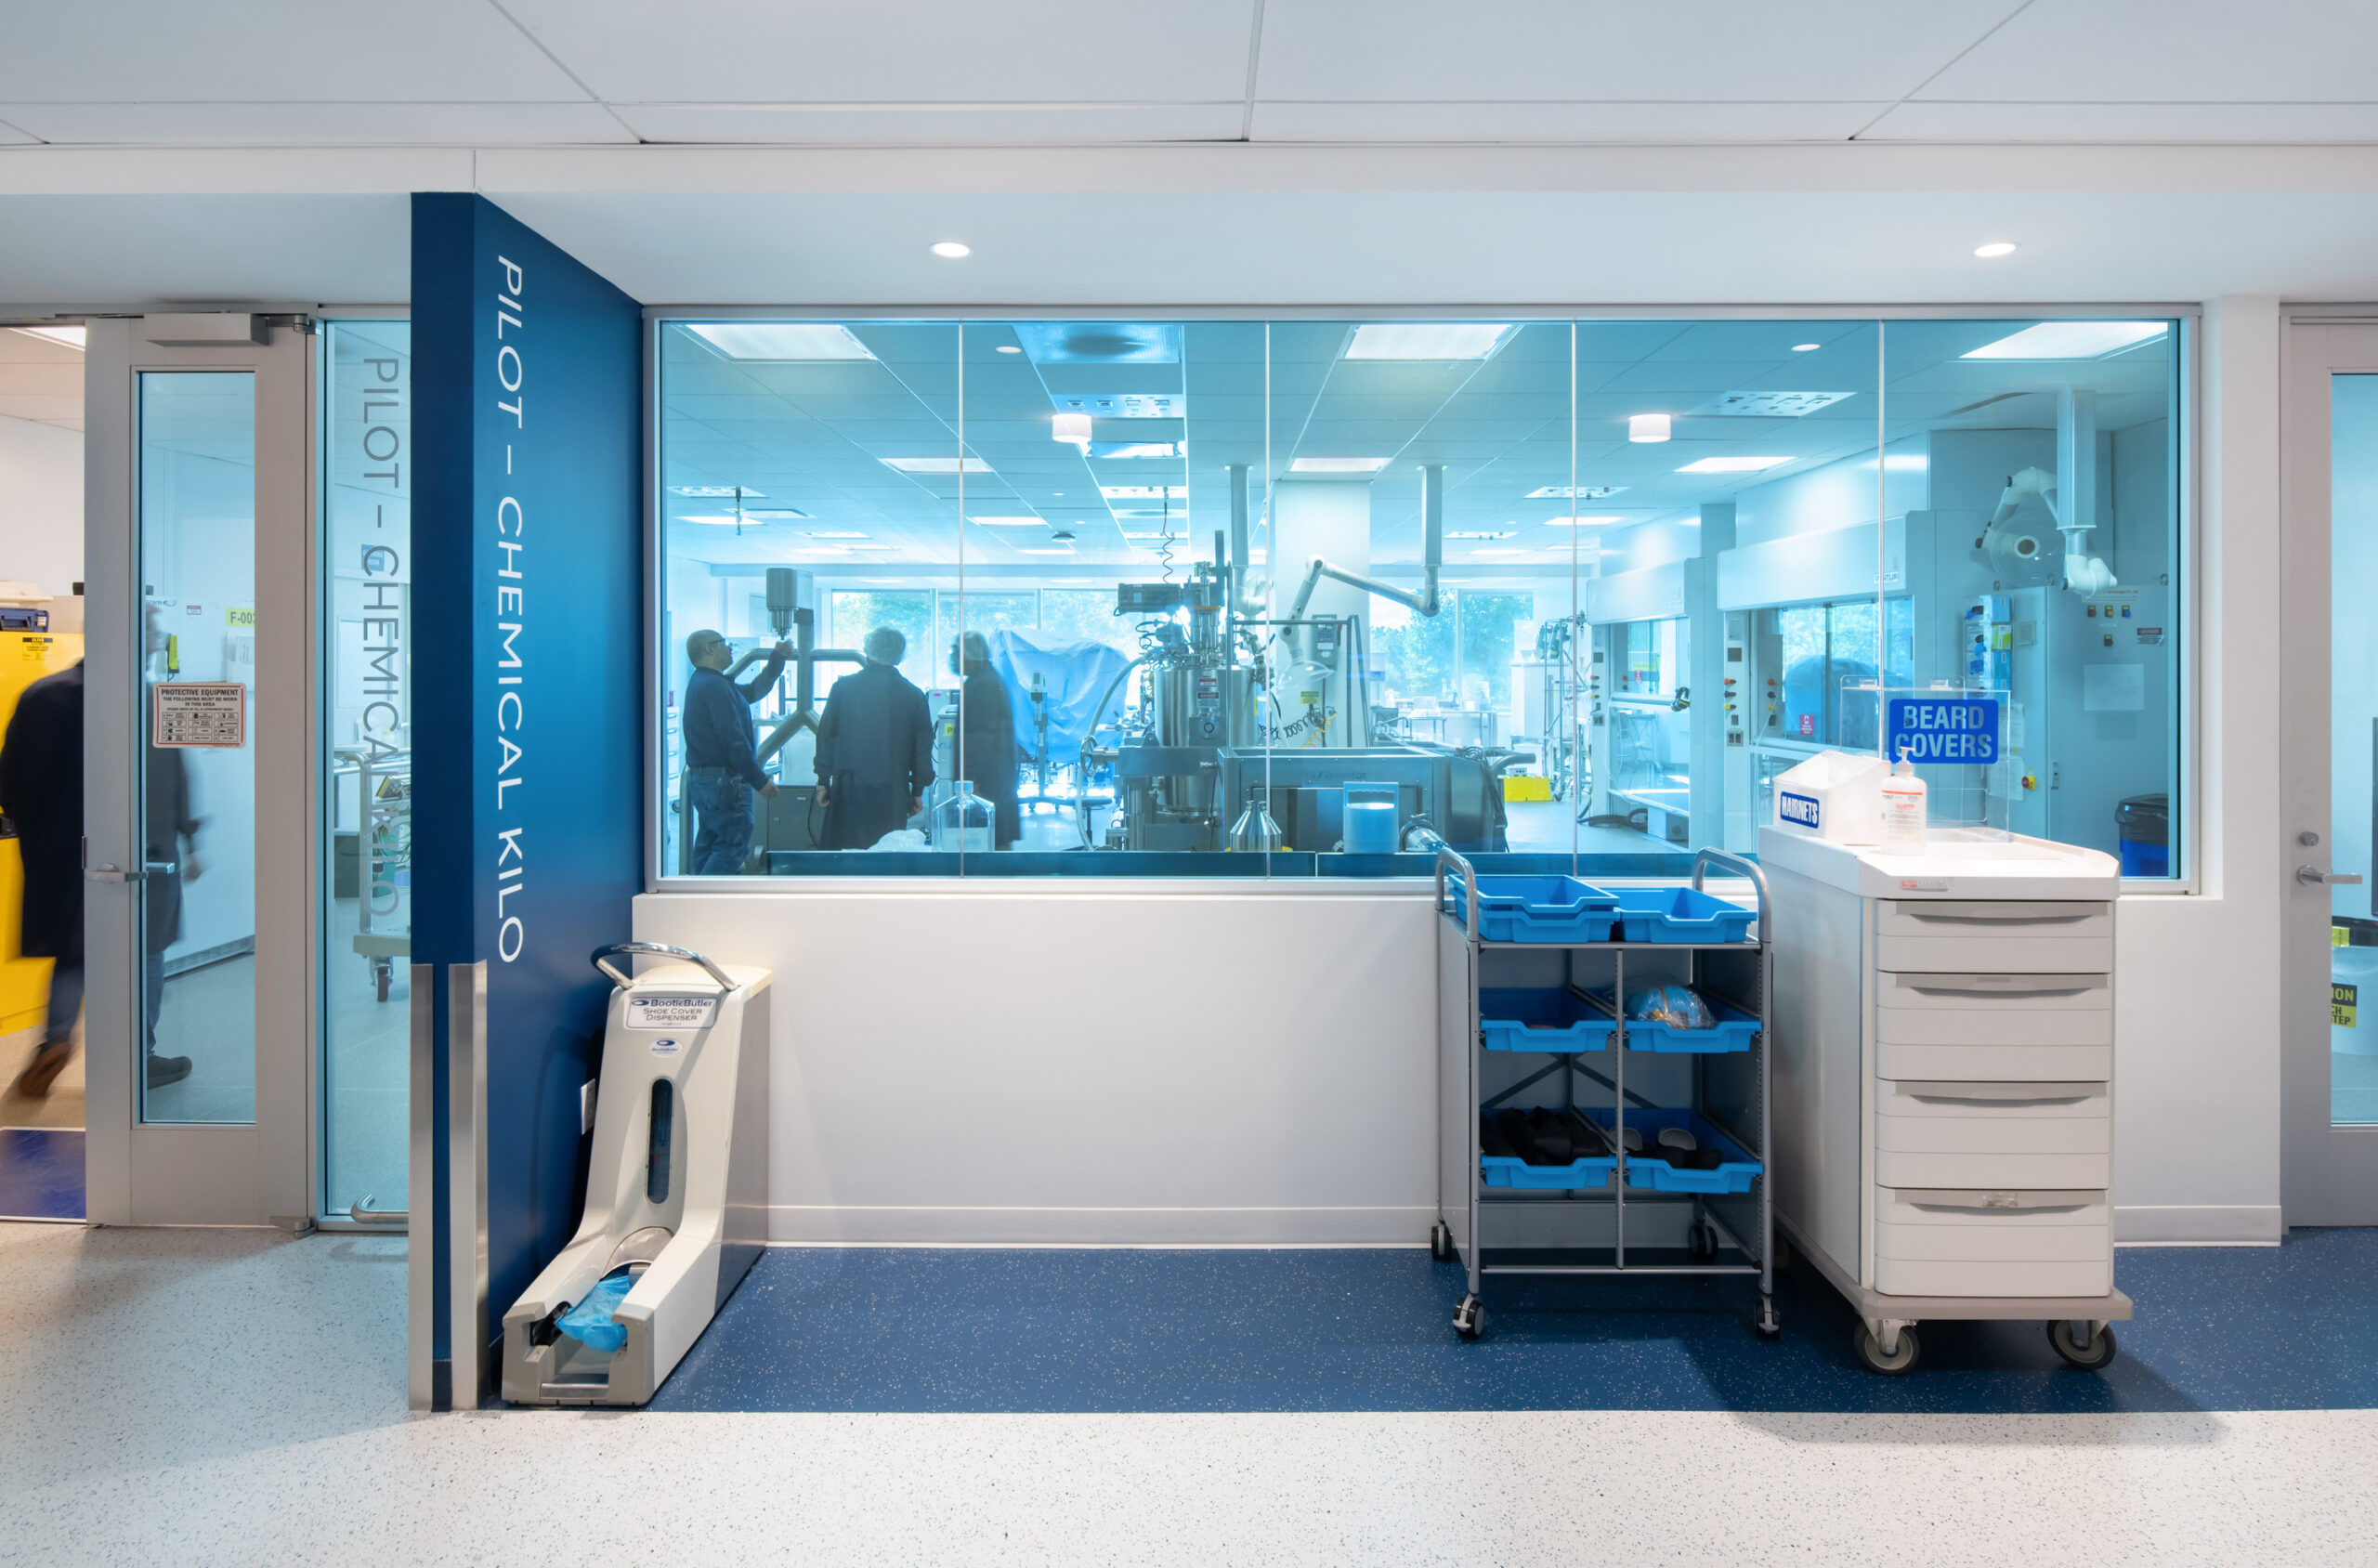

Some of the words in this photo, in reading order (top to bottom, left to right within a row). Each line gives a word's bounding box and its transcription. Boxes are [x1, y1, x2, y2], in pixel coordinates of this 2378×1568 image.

[498, 255, 522, 429] PILOT
[363, 358, 399, 489] PILOT
[363, 545, 399, 792] CHEMICAL
[498, 496, 523, 810] CHEMICAL
[1903, 705, 1984, 729] BEARD
[1782, 795, 1818, 825] HAIRNETS
[1895, 733, 1993, 758] COVERS
[499, 828, 524, 963] KILO
[650, 999, 712, 1007] BootieButler
